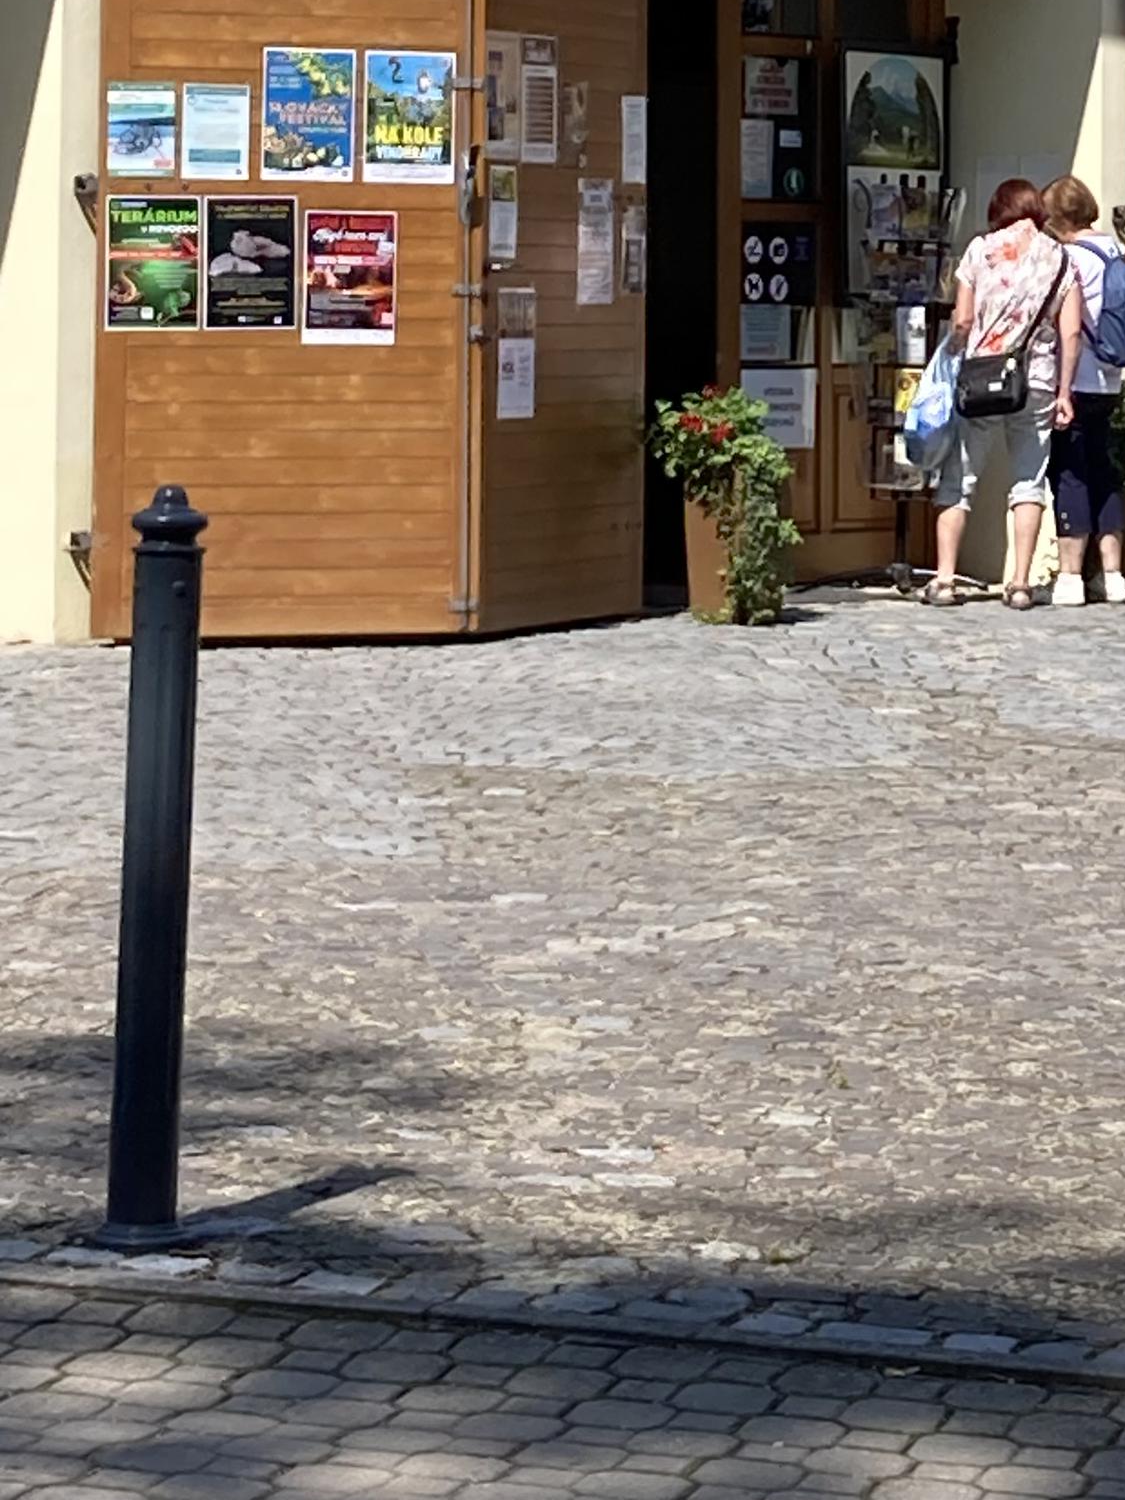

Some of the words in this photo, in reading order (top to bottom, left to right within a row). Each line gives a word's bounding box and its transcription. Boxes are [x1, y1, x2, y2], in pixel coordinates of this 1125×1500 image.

[374, 123, 401, 145] NA
[402, 123, 444, 145] KOLE
[110, 206, 197, 224] TERÁRIUM
